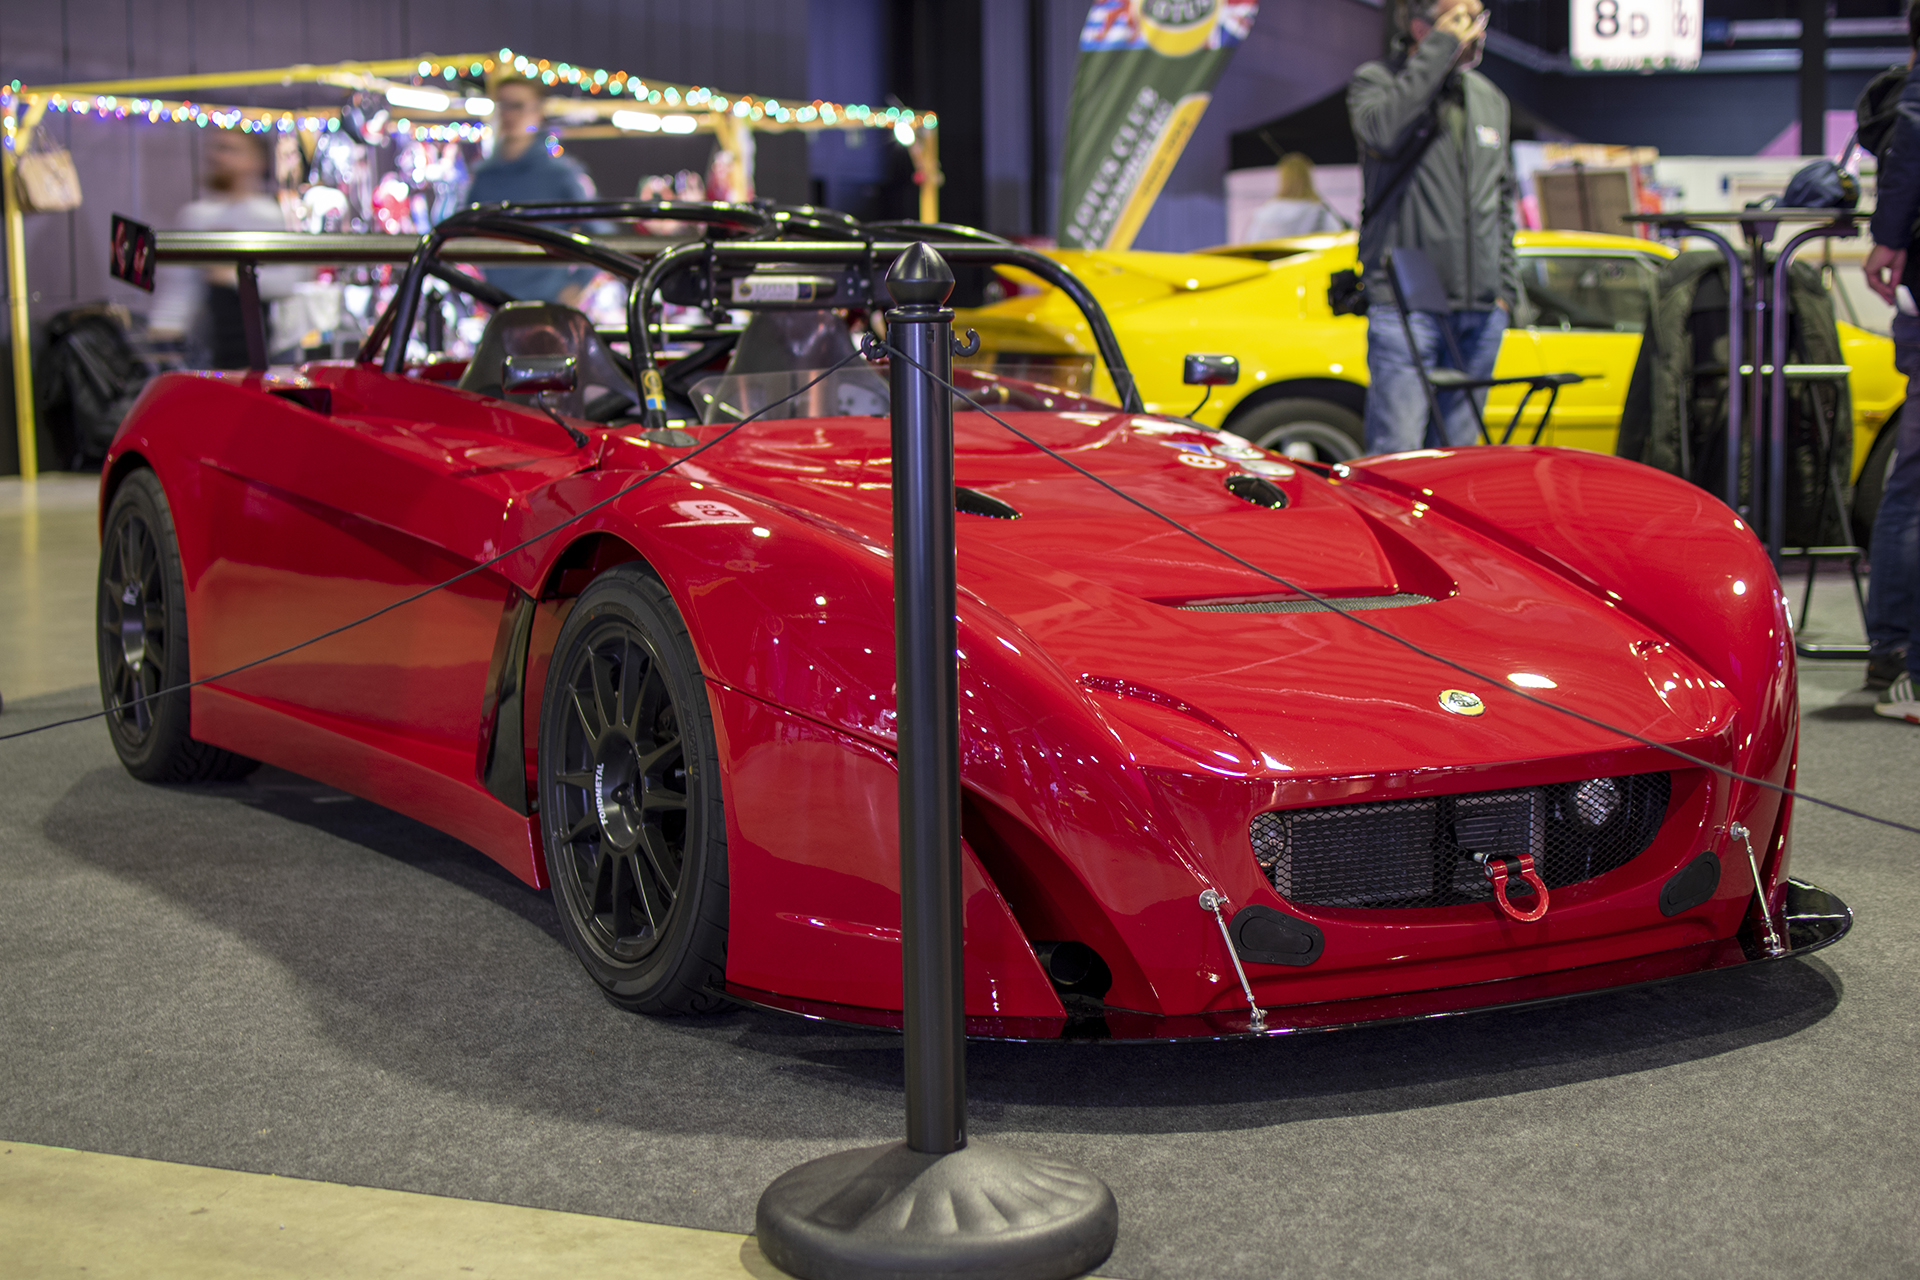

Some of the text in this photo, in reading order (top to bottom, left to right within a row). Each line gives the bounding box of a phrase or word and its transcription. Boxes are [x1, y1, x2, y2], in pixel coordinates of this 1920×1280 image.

[1066, 85, 1159, 242] LOTUS CLUB
[595, 763, 609, 825] FONDMETAL
